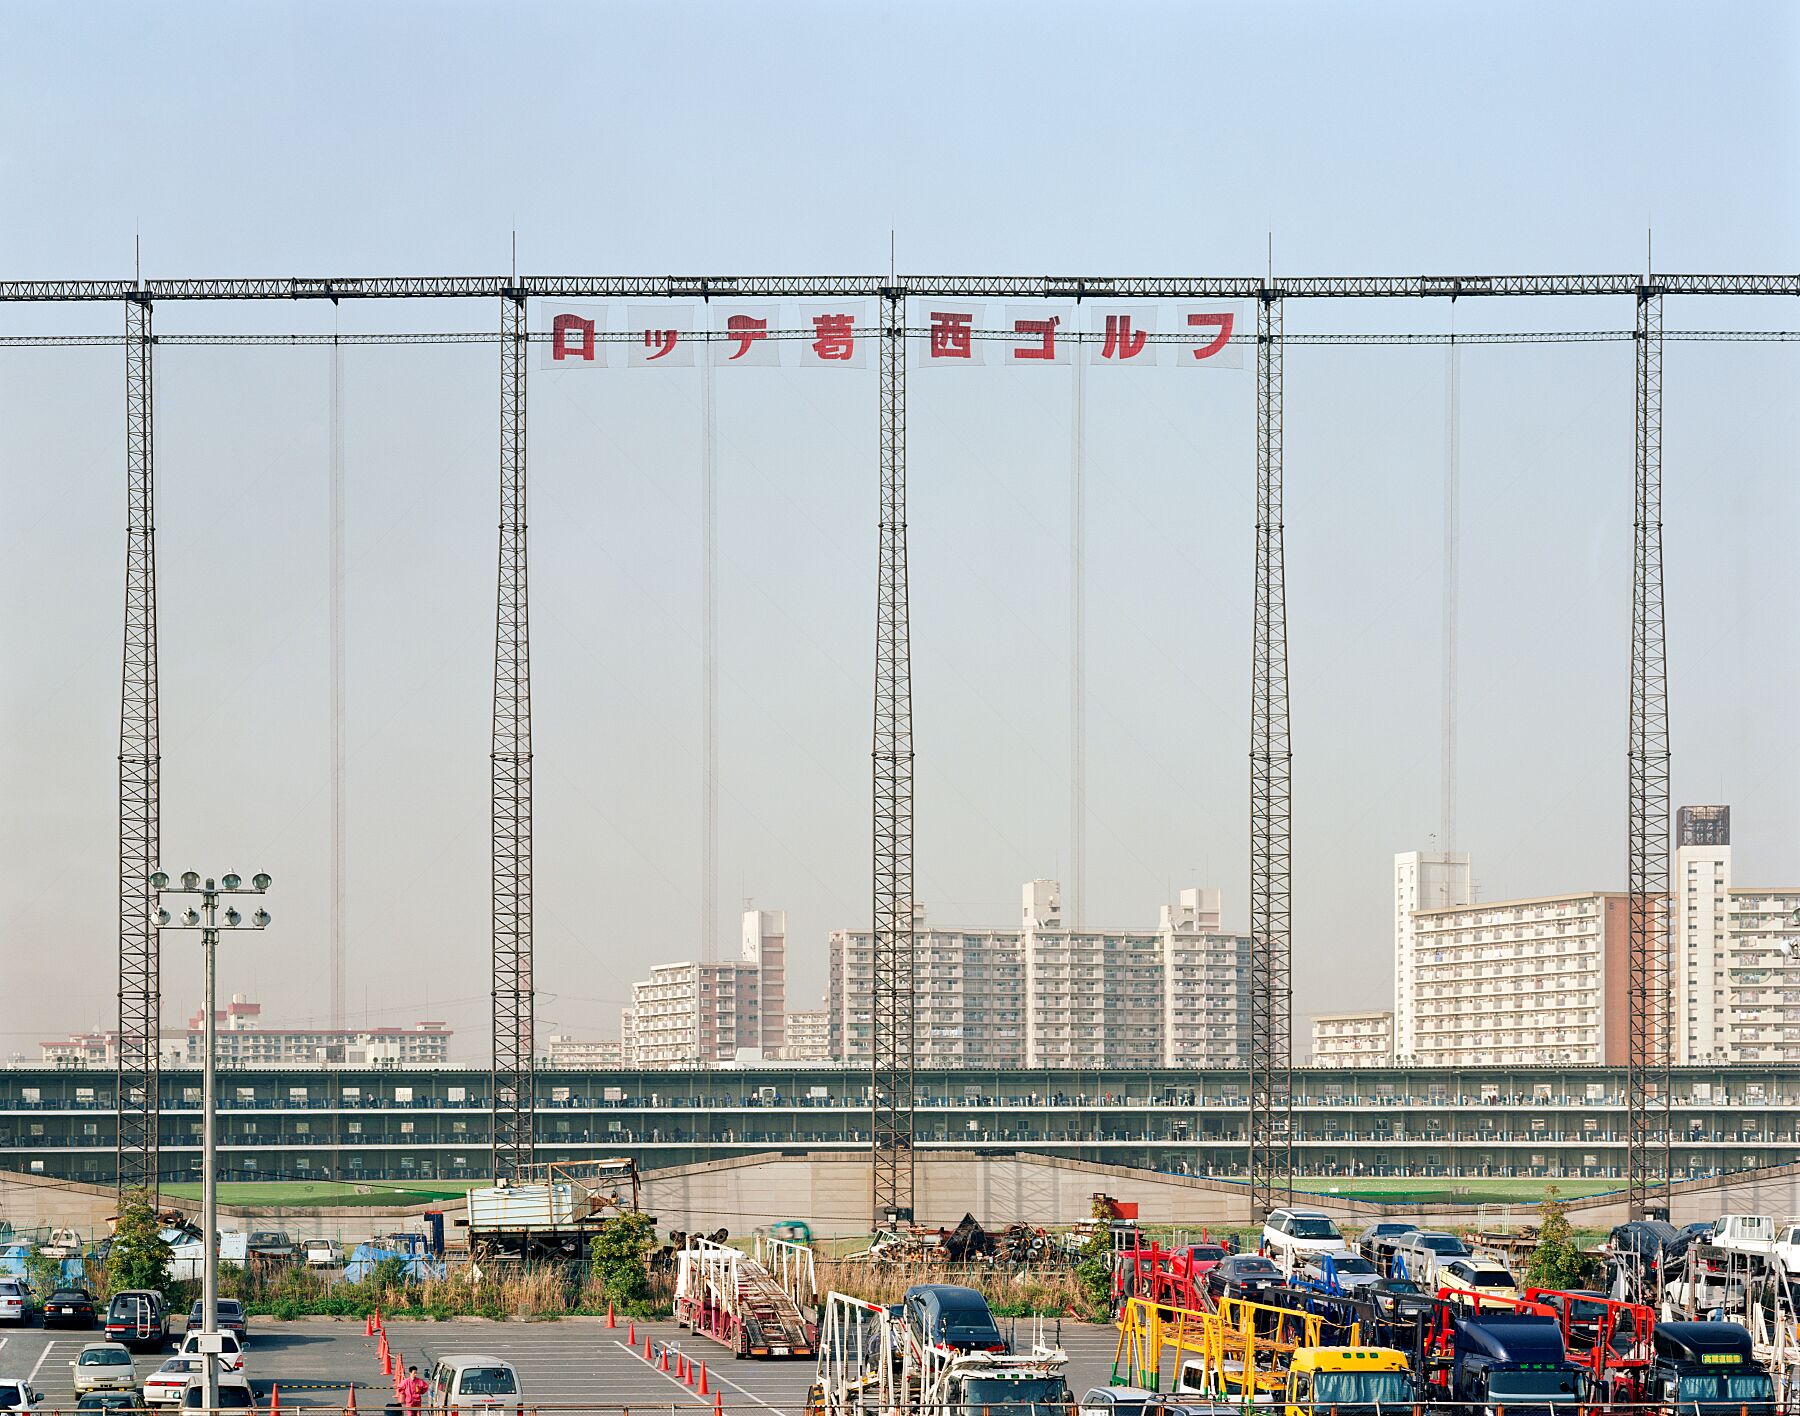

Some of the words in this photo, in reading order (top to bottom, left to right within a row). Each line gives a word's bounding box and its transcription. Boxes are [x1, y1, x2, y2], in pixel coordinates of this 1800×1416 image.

[553, 312, 1234, 361] ロッテ葛西ゴルフ
